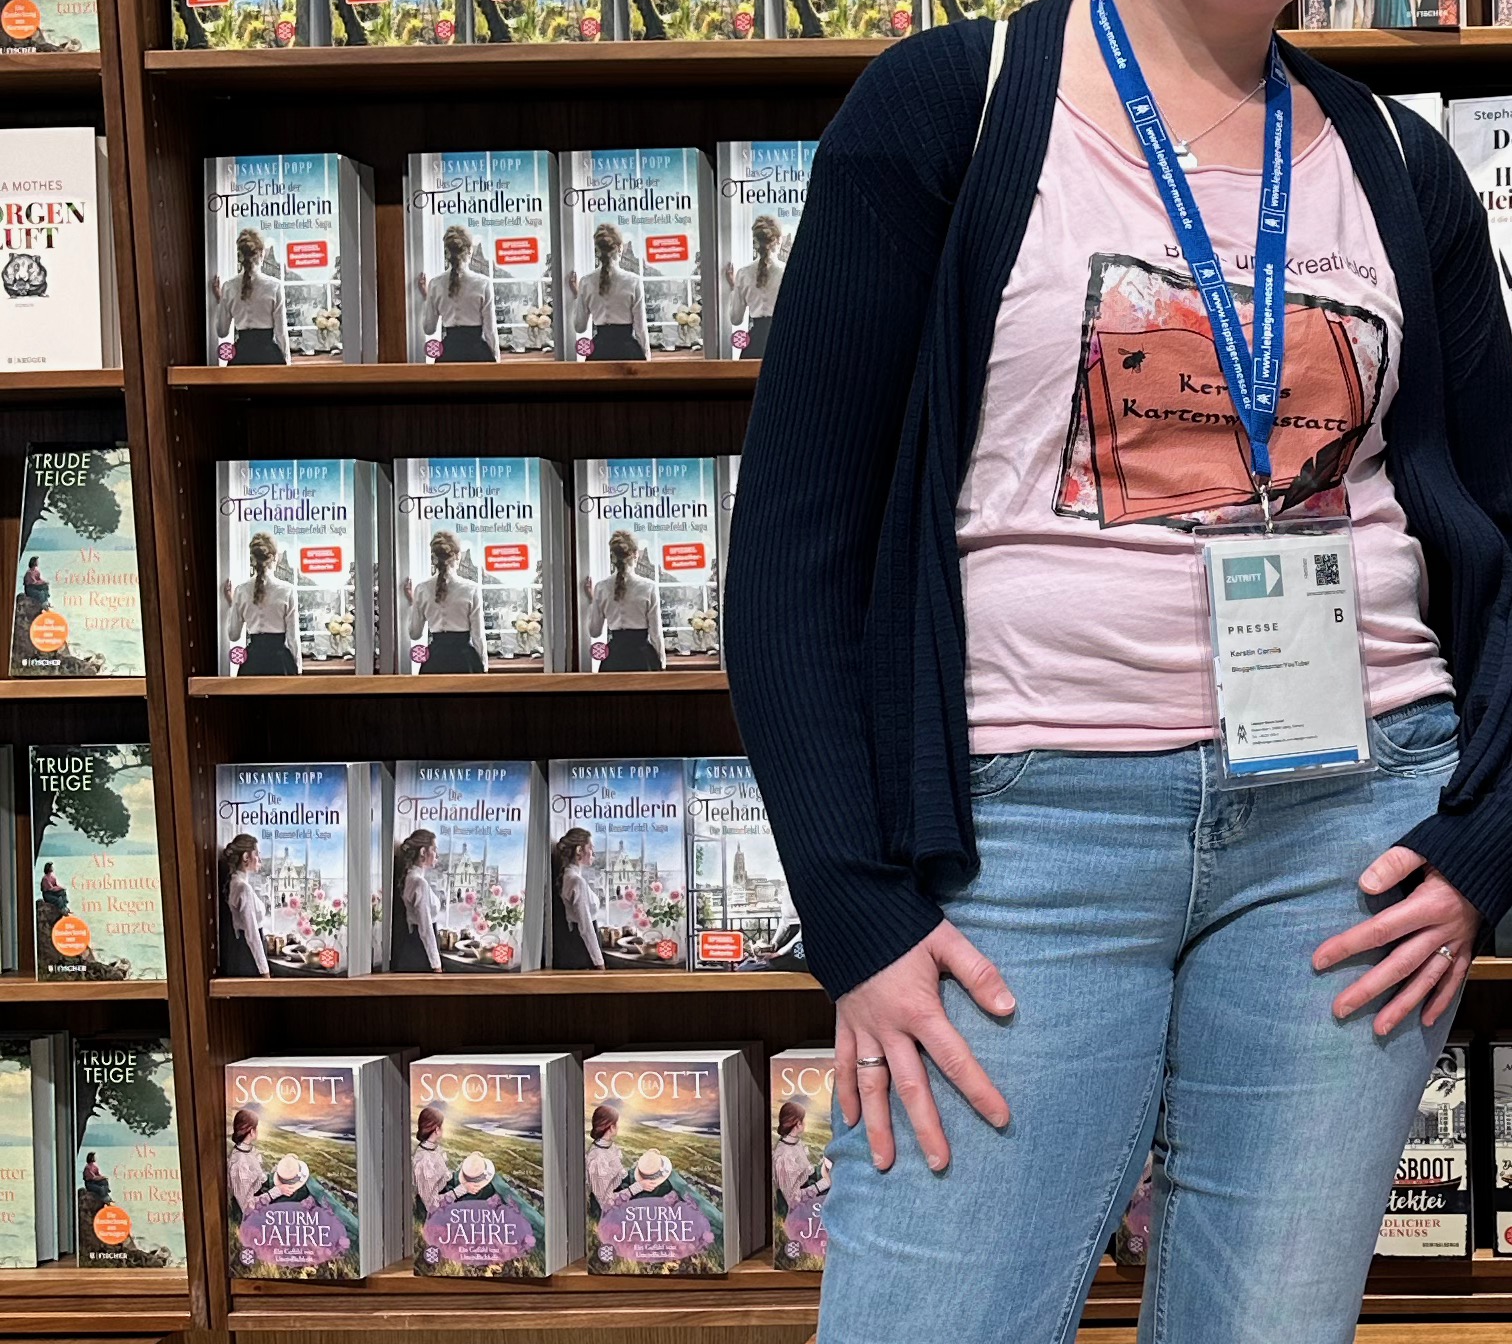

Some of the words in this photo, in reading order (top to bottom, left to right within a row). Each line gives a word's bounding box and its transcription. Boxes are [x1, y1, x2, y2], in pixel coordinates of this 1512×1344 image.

[12, 179, 63, 193] MOTHES
[615, 173, 644, 193] Erbe
[647, 178, 661, 191] der
[564, 187, 692, 215] Teehändlerin
[0, 202, 85, 225] RGEN
[0, 227, 59, 250] UFT
[452, 481, 482, 498] Erbe
[486, 484, 500, 496] der
[399, 495, 533, 522] Teehändlerin
[1334, 608, 1344, 623] B
[1228, 623, 1279, 634] PRESSE
[36, 757, 93, 774] TRUDE
[39, 775, 92, 792] TEIGE
[238, 771, 290, 785] SUSANNE
[294, 770, 324, 785] POPP
[267, 791, 282, 806] Die
[219, 800, 341, 828] Teehändlerin
[233, 1074, 344, 1106] SCOTT
[264, 1209, 321, 1227] STURM
[253, 1221, 332, 1249] JAHRE
